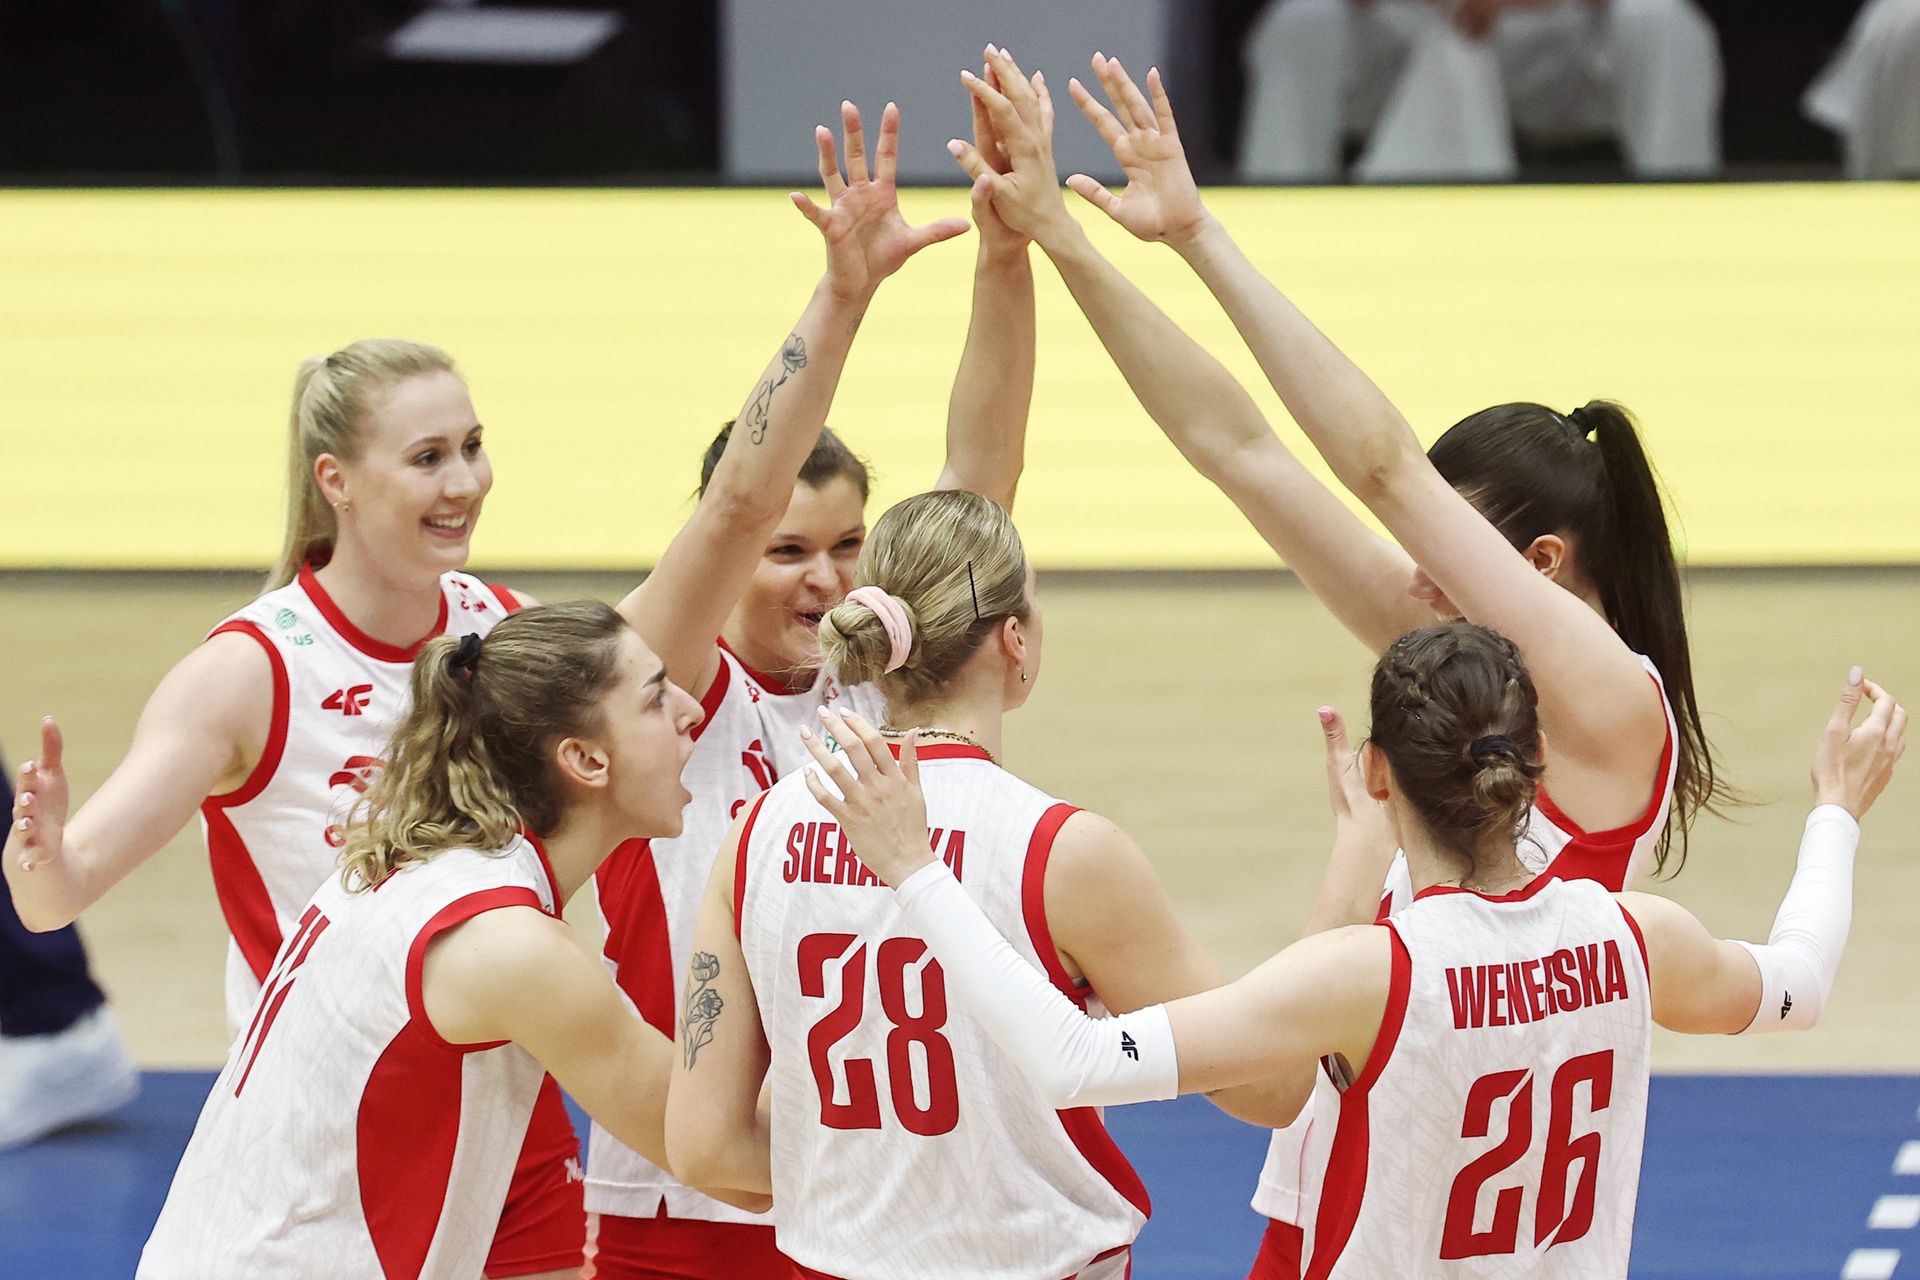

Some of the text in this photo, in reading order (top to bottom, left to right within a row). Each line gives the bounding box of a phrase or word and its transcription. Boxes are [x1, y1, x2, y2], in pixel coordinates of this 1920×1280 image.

[321, 684, 373, 715] 4F
[797, 933, 960, 1136] 28
[1445, 939, 1629, 1030] WENERSKA
[1439, 1049, 1615, 1260] 26
